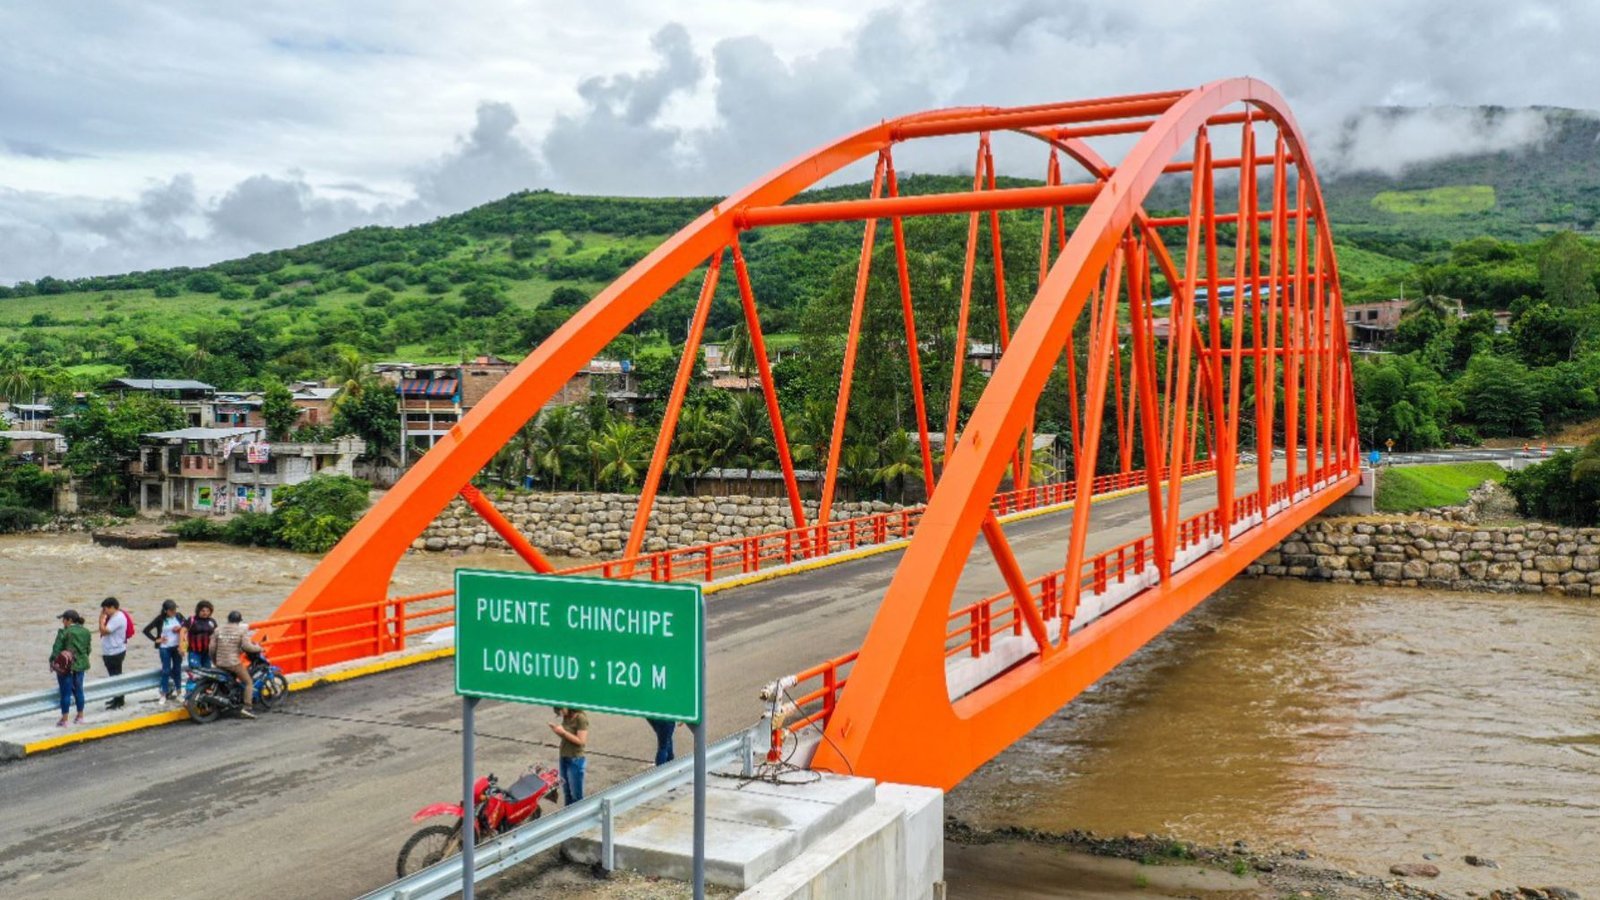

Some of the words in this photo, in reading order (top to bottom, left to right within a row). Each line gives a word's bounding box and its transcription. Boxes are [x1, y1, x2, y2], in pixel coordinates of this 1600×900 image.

[477, 597, 550, 627] PUENTE
[567, 604, 674, 638] CHINCHIPE
[483, 648, 579, 681] LONGITUD
[607, 660, 642, 688] 120
[651, 664, 667, 690] M
